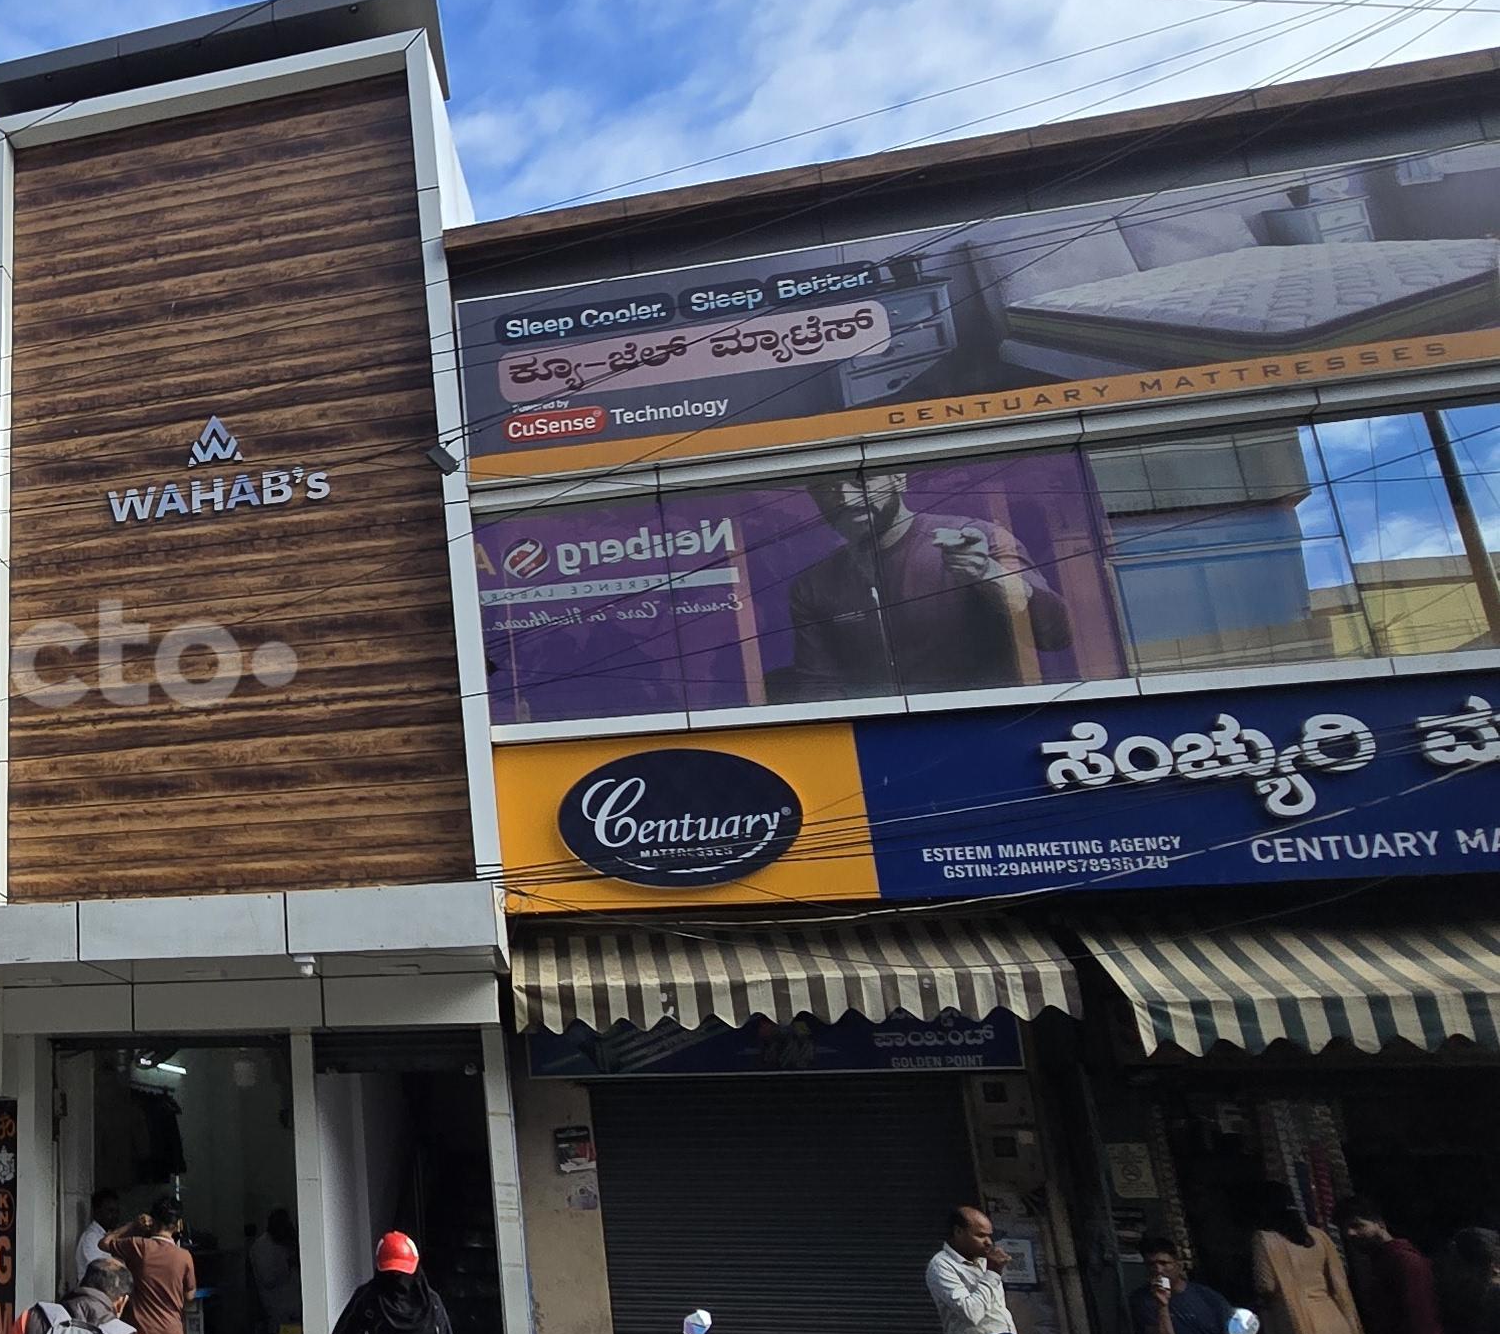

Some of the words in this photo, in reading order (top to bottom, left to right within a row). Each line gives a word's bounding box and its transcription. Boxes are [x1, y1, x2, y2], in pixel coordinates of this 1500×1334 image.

[506, 317, 574, 338] Sleep
[580, 303, 666, 328] Cooler.
[691, 288, 763, 312] Sleep
[887, 384, 1111, 426] CENTUARY
[1139, 341, 1450, 394] MATTRESSES
[557, 398, 569, 409] by
[610, 399, 728, 425] Technology
[581, 777, 780, 847] Centuary
[922, 845, 992, 862] ESTEEM
[998, 839, 1103, 860] MARKETING
[1109, 835, 1181, 854] AGENCY
[1251, 830, 1440, 864] CENTUARY
[891, 1055, 942, 1068] GOLDEN
[945, 1054, 984, 1067] POINT
